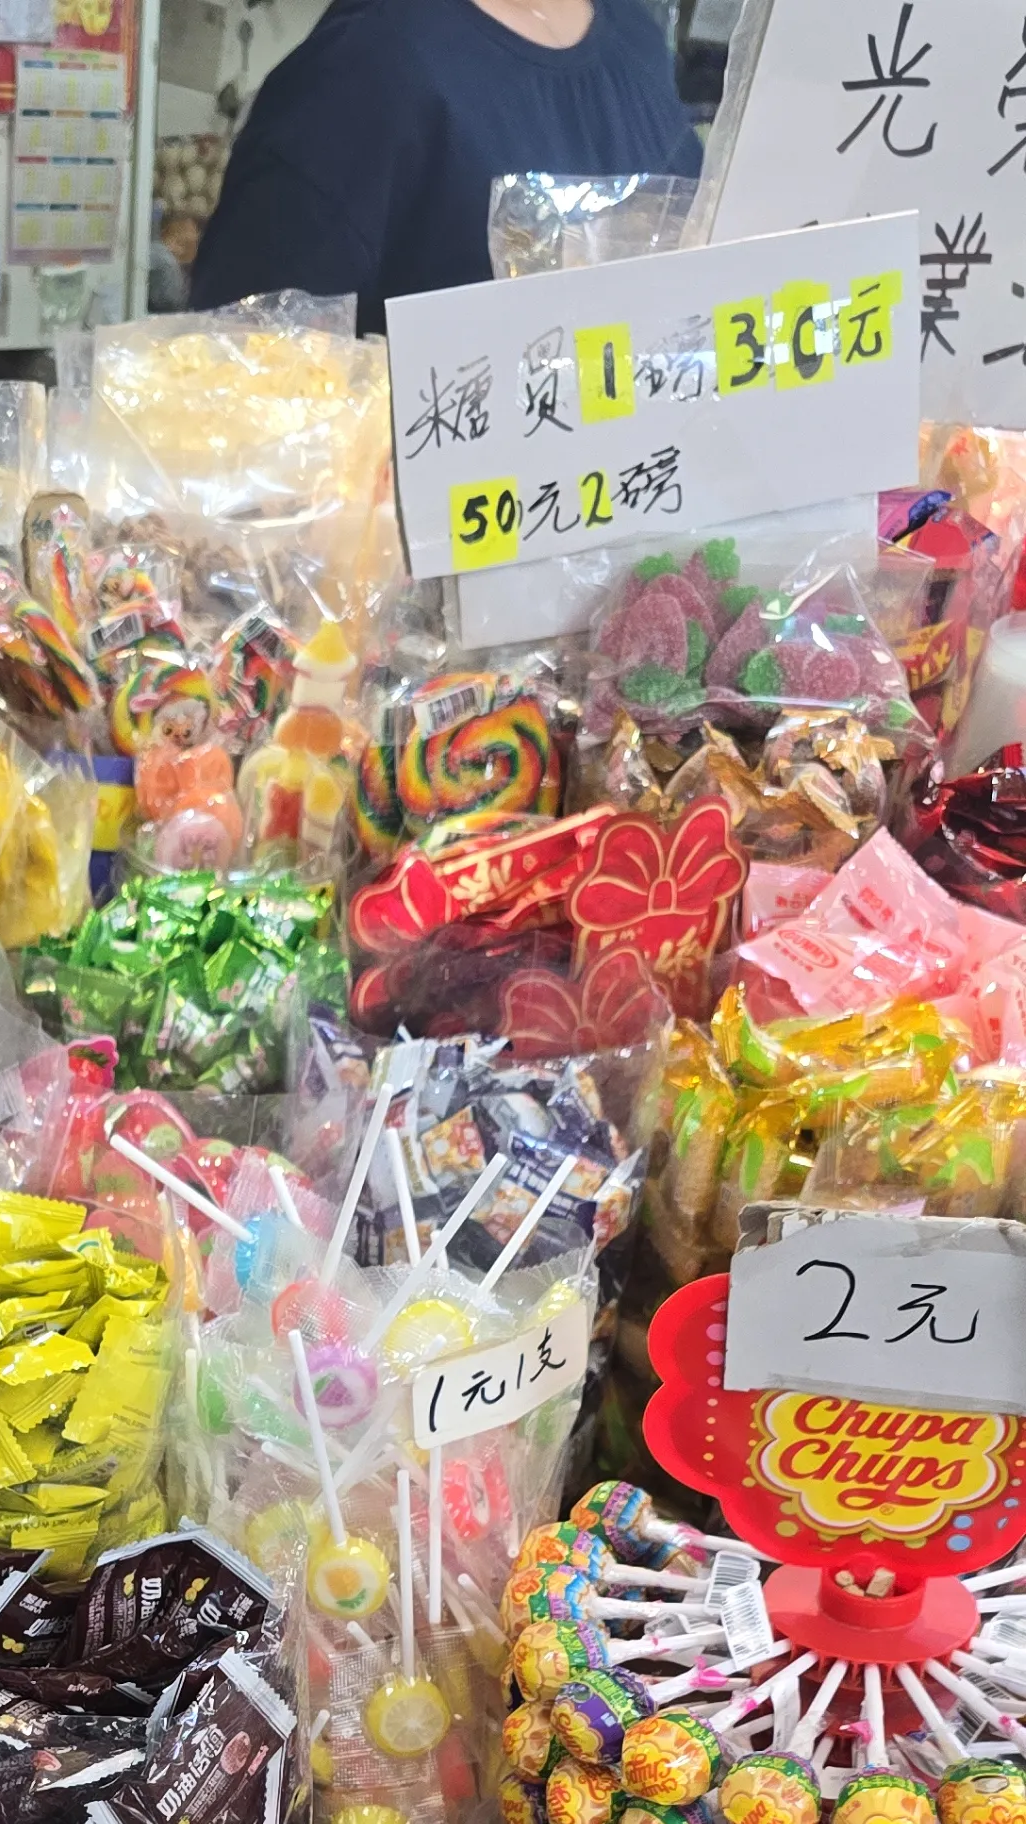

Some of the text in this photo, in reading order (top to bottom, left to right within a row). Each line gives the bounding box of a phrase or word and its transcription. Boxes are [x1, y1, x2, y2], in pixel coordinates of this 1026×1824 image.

[795, 1259, 981, 1345] 2元
[428, 1325, 567, 1434] 1元1支
[792, 1394, 989, 1455] Chupa
[778, 1438, 969, 1511] Chups
